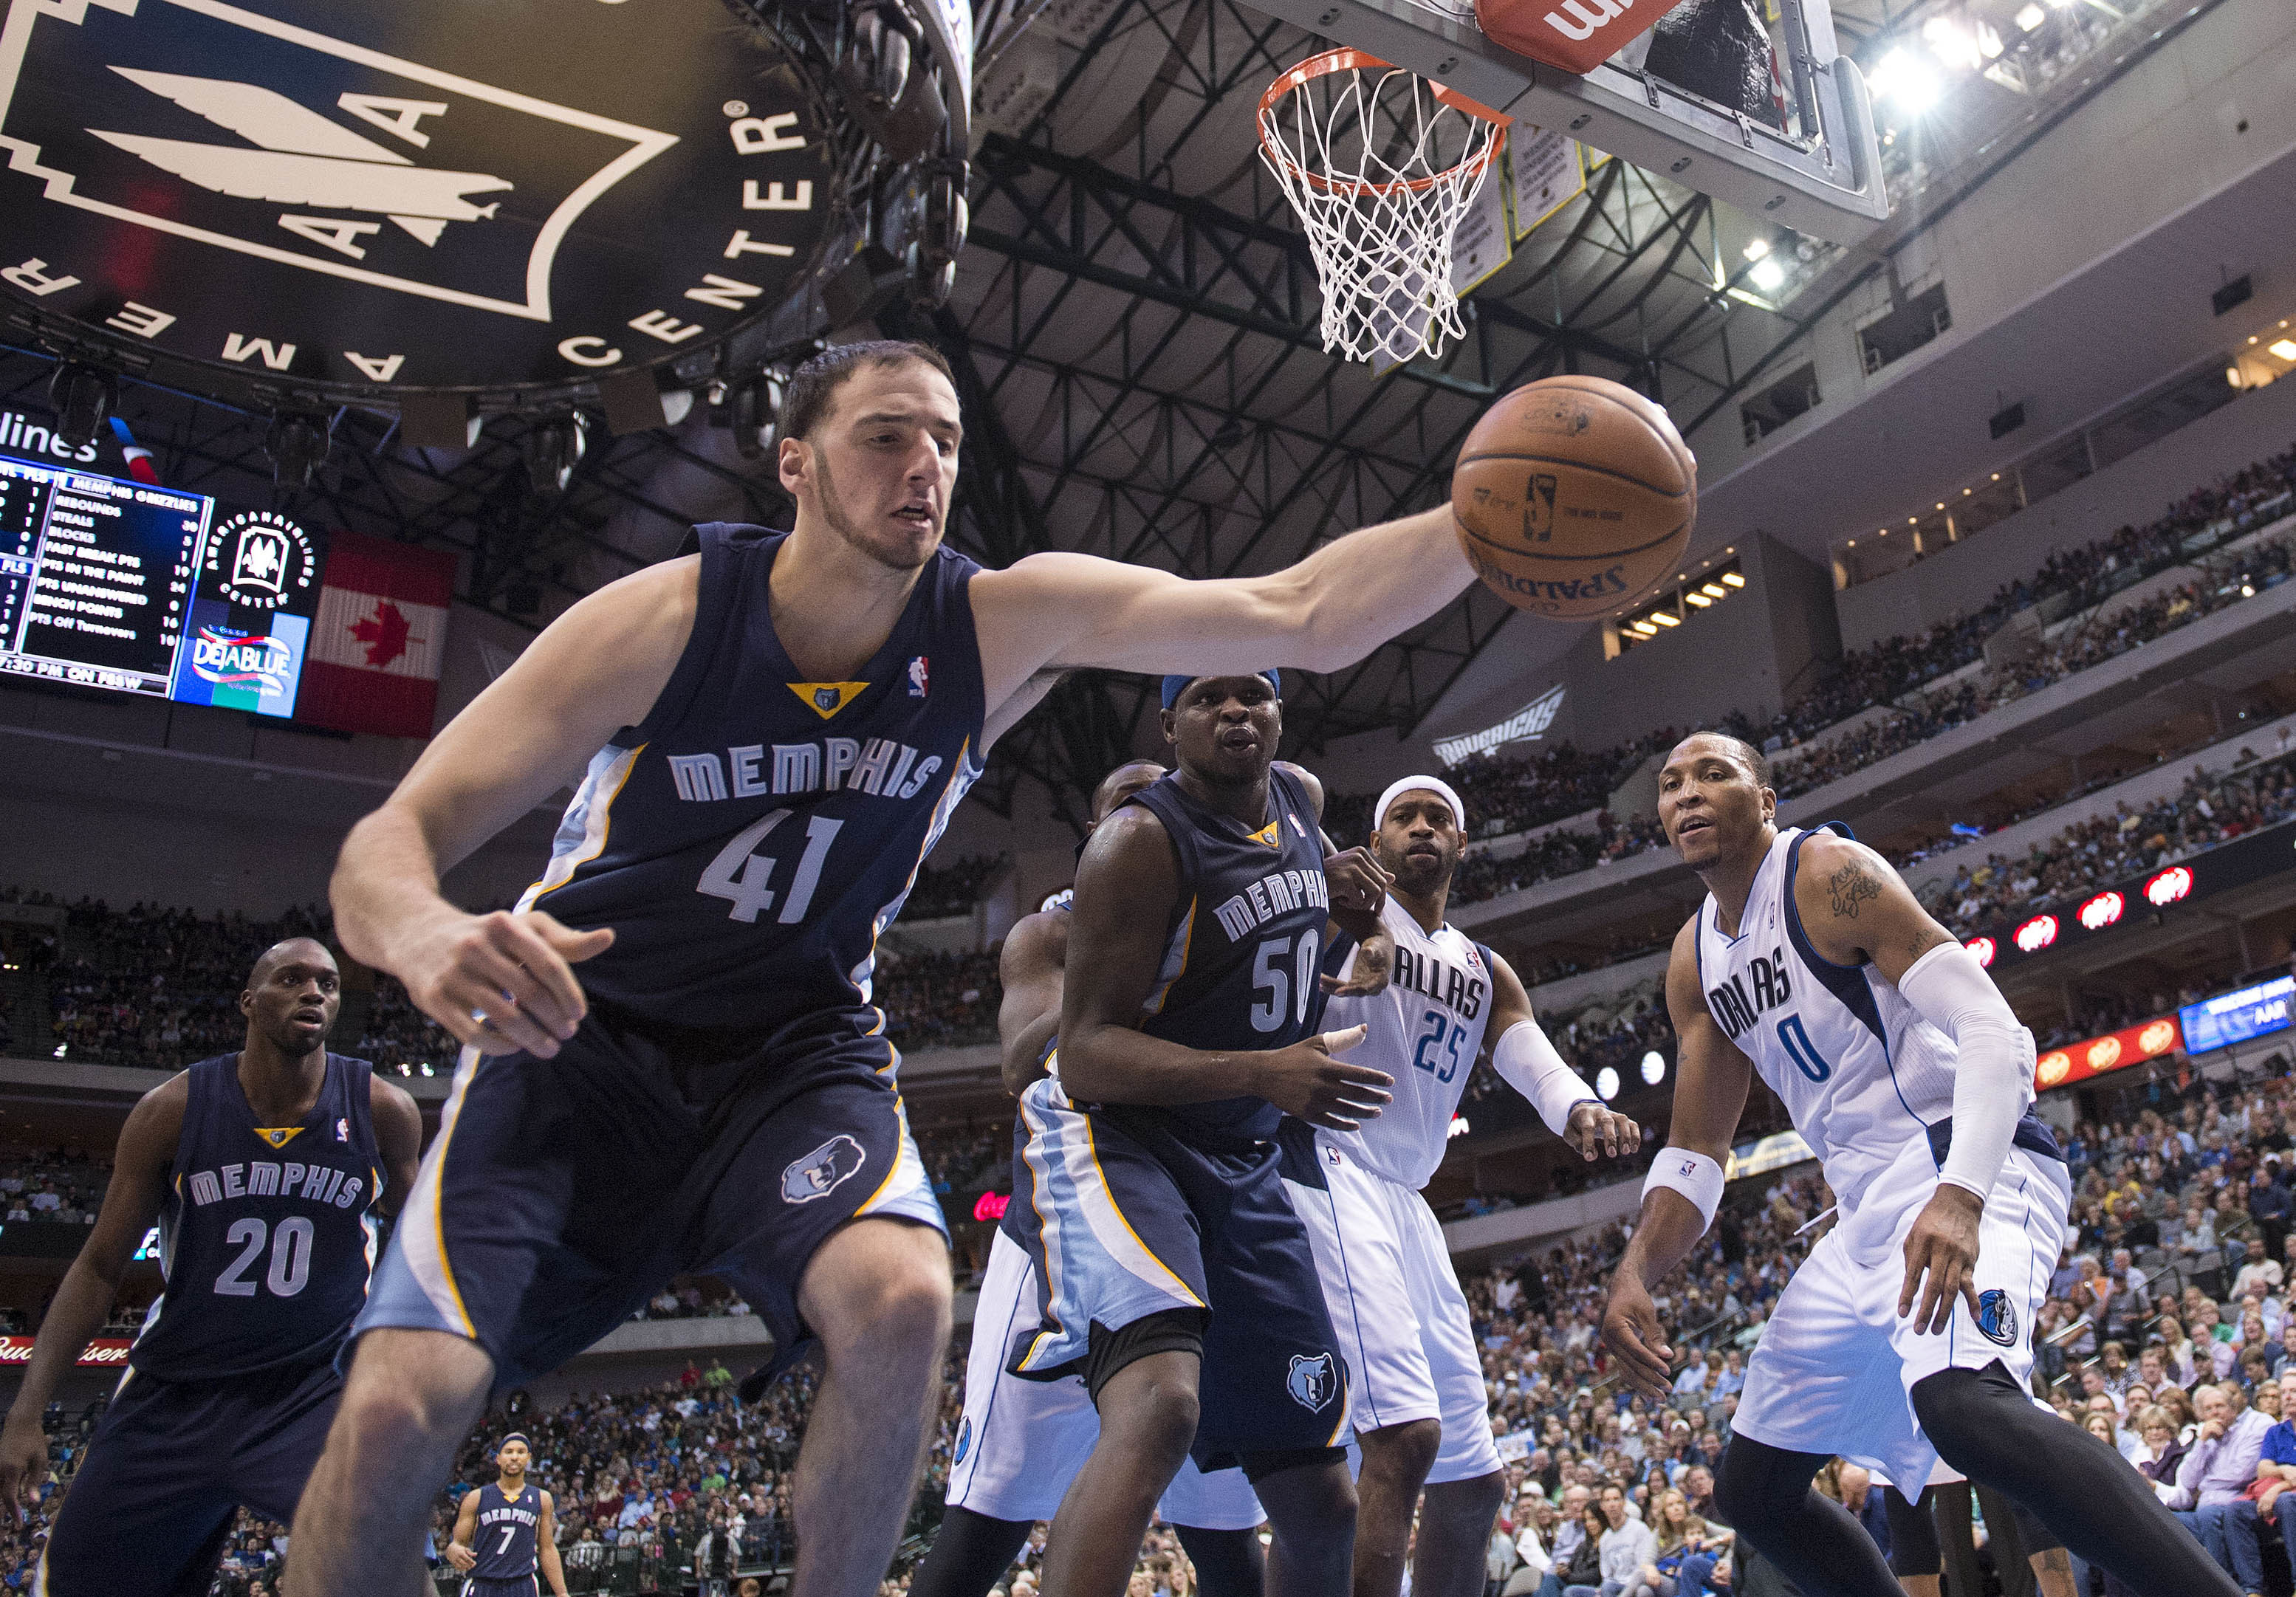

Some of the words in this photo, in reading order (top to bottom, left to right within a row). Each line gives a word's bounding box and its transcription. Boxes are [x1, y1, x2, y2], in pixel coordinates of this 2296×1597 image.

[558, 111, 812, 368] CENTER
[55, 495, 122, 518] REBOUNDS
[72, 477, 134, 500] MEMPHIS
[135, 490, 198, 512] GRIZZLIES
[52, 510, 95, 528] STEALS
[47, 525, 96, 544] BLOCKS
[205, 511, 272, 571] AMERICAN
[273, 514, 316, 588] AIRLINES
[45, 540, 76, 557] FAST
[76, 546, 117, 565] BREAK
[117, 554, 141, 569] PTS
[36, 577, 61, 591] PTS
[41, 557, 64, 572] PTS
[65, 563, 82, 575] IN
[83, 566, 106, 580] THE
[106, 569, 146, 587] PAINT
[32, 594, 77, 611] BENCH
[76, 600, 124, 619] POINTS
[219, 582, 289, 609] CENTER
[29, 611, 52, 625] PTS
[53, 616, 75, 629] Off
[75, 619, 137, 640] Turnovers
[37, 661, 64, 678] PM
[67, 667, 95, 683] ON
[666, 737, 943, 803] MEMPHIS
[696, 808, 846, 924] 41
[1250, 928, 1319, 1033] 50
[1391, 944, 1484, 1022] ALLAS
[1413, 1009, 1467, 1084] 25
[1776, 1012, 1832, 1084] 0
[188, 1161, 363, 1209] MEMPHIS
[214, 1216, 315, 1297] 20
[480, 1508, 537, 1527] MEMPHIS
[496, 1526, 516, 1555] 7
